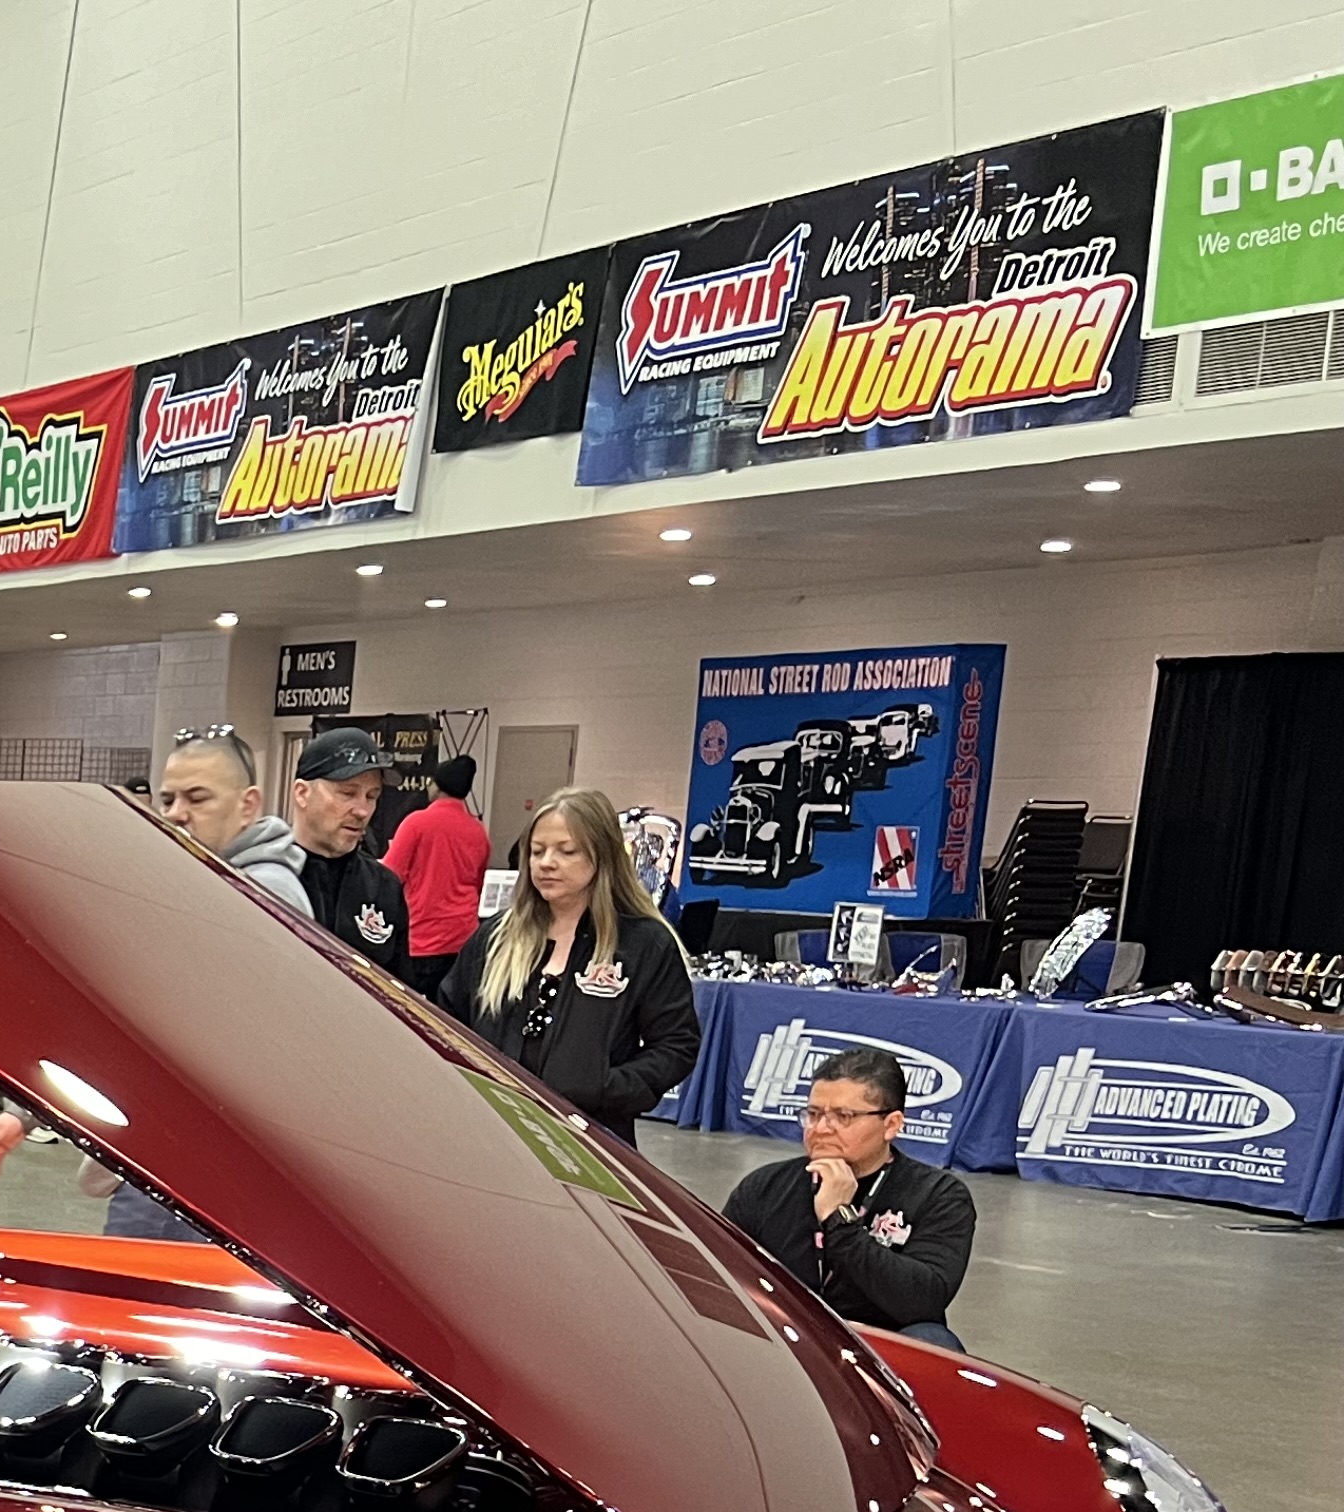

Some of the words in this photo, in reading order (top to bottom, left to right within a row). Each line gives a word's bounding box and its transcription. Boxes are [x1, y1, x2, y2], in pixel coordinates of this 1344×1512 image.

[821, 221, 946, 279] Welcomes
[940, 206, 1003, 280] You
[1006, 196, 1034, 239] to
[1034, 178, 1092, 230] the
[1198, 232, 1231, 257] We
[1237, 220, 1302, 250] create
[996, 238, 1116, 294] Detroit
[254, 359, 324, 401] Welcomes
[323, 352, 359, 406] You
[360, 346, 378, 380] to
[378, 333, 410, 375] the
[457, 282, 584, 421] Meguiar's
[639, 357, 692, 383] RACING
[693, 341, 779, 374] EQUIPMENT
[760, 276, 1134, 440] Autorama
[217, 414, 411, 524] Autoram
[21, 527, 58, 552] PARTS
[297, 651, 336, 671] MEN'S
[702, 668, 764, 697] NATIONAL
[769, 664, 819, 694] STREET
[822, 662, 851, 692] ROD
[853, 655, 952, 691] ASSOCIATION
[277, 686, 350, 708] RESTROOMS
[873, 848, 915, 887] NSRA
[1093, 1086, 1187, 1120] ADVANCED
